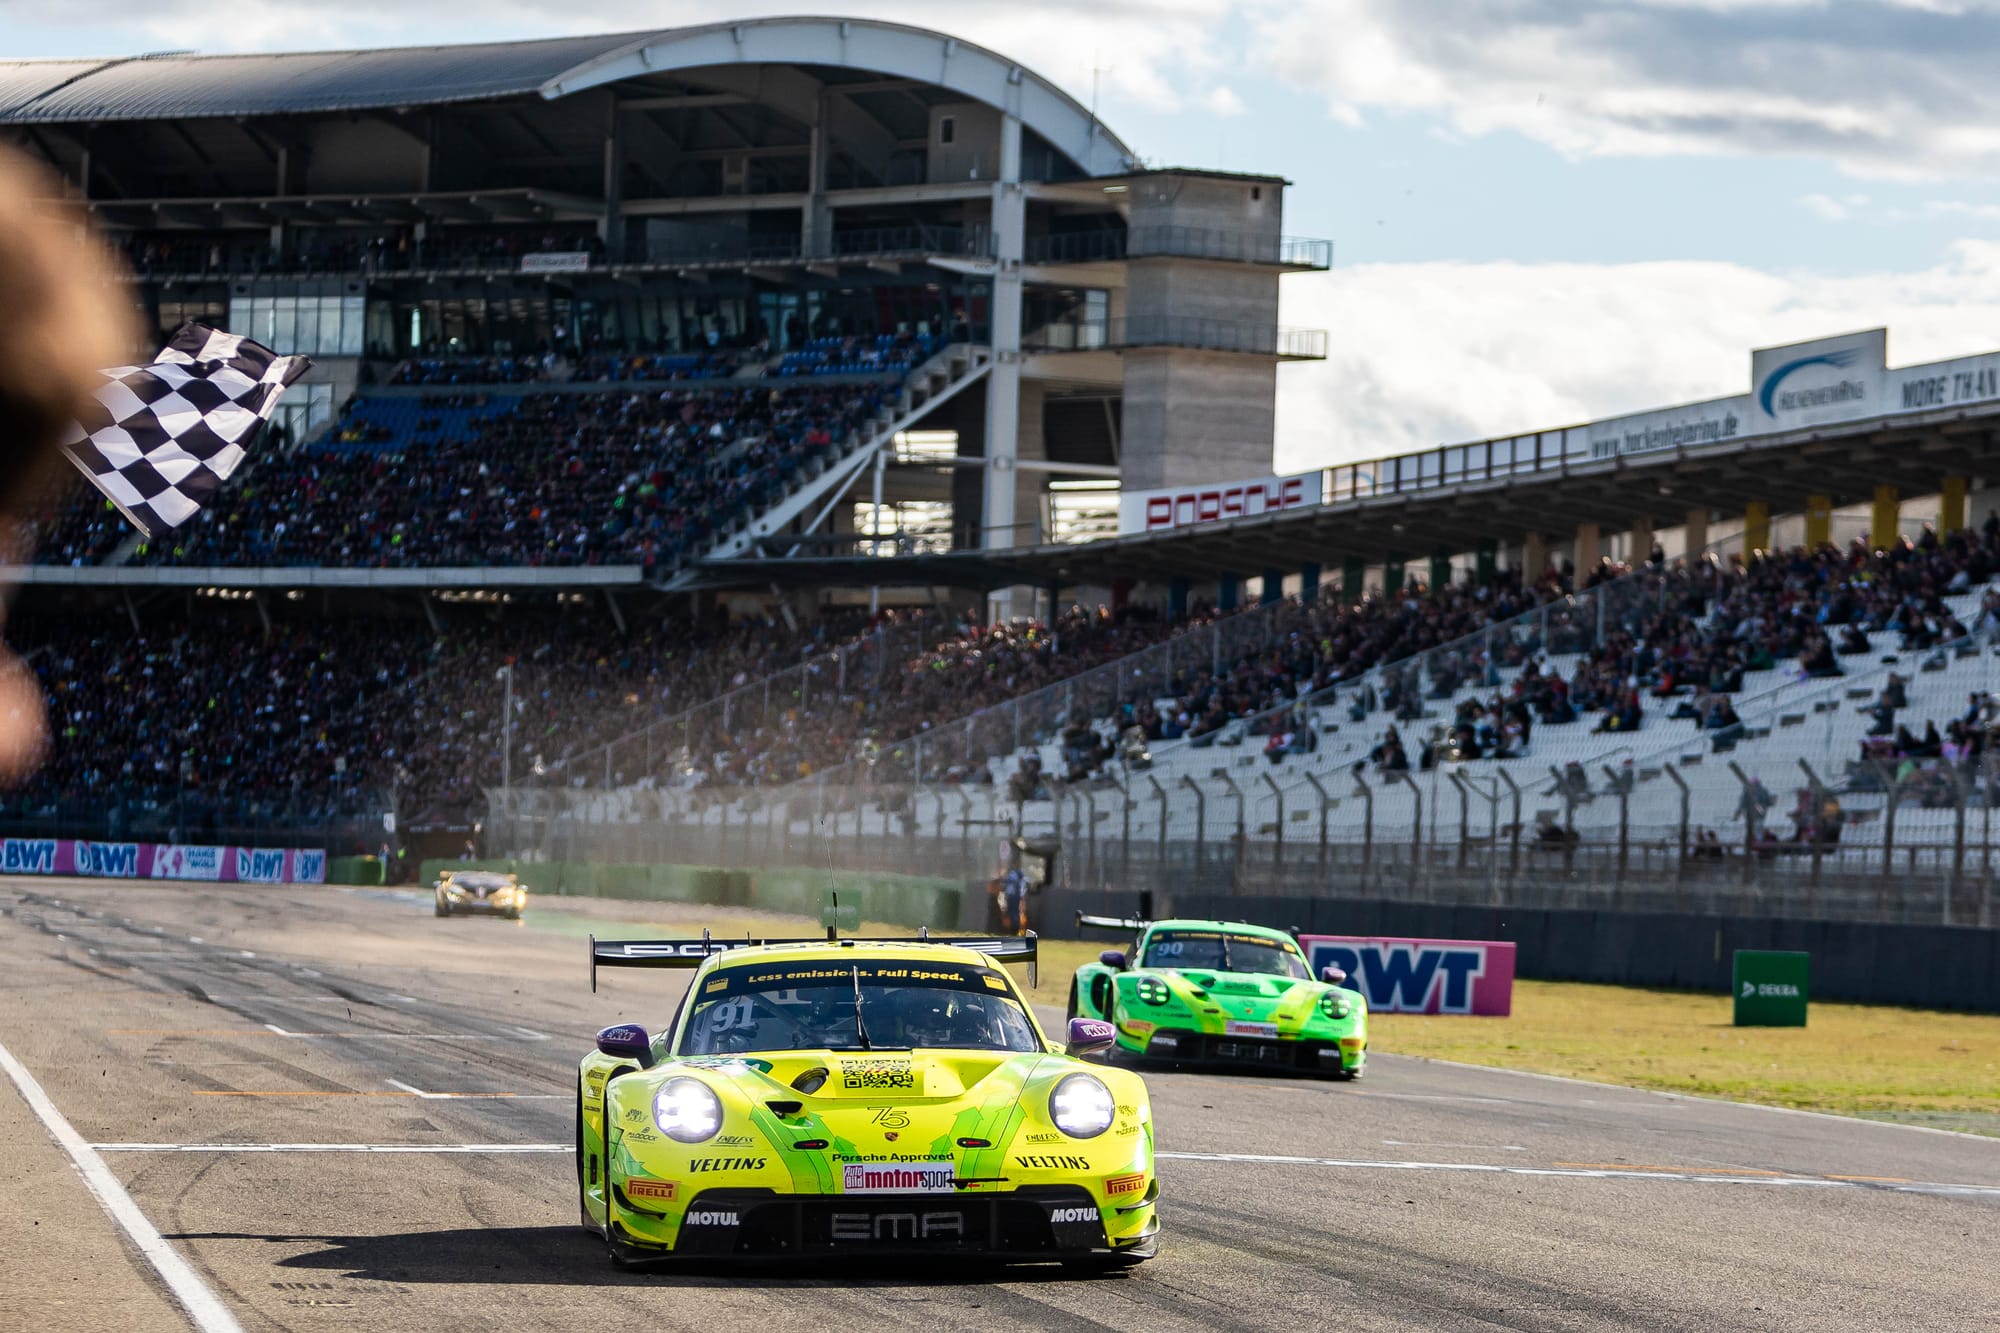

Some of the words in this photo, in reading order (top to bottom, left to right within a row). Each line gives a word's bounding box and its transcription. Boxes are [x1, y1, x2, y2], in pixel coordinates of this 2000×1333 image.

[1902, 375, 1947, 408] MORE
[1146, 478, 1302, 531] PORSCHE
[5, 840, 55, 870] BWT
[1157, 942, 1184, 957] 90
[749, 973, 783, 983] Less
[877, 969, 907, 978] Full
[911, 970, 964, 982] Speed.
[1311, 944, 1483, 1012] BWT
[711, 998, 755, 1032] 91
[832, 1153, 887, 1162] Porsche
[890, 1152, 955, 1162] Approved
[1015, 1156, 1090, 1170] VELTINS
[690, 1158, 767, 1173] VELTINS
[845, 1166, 863, 1177] Auto
[628, 1180, 674, 1198] PIRELLI
[1105, 1174, 1145, 1194] PIRELLI
[686, 1211, 740, 1226] MOTUL
[1051, 1207, 1099, 1223] MOTUL
